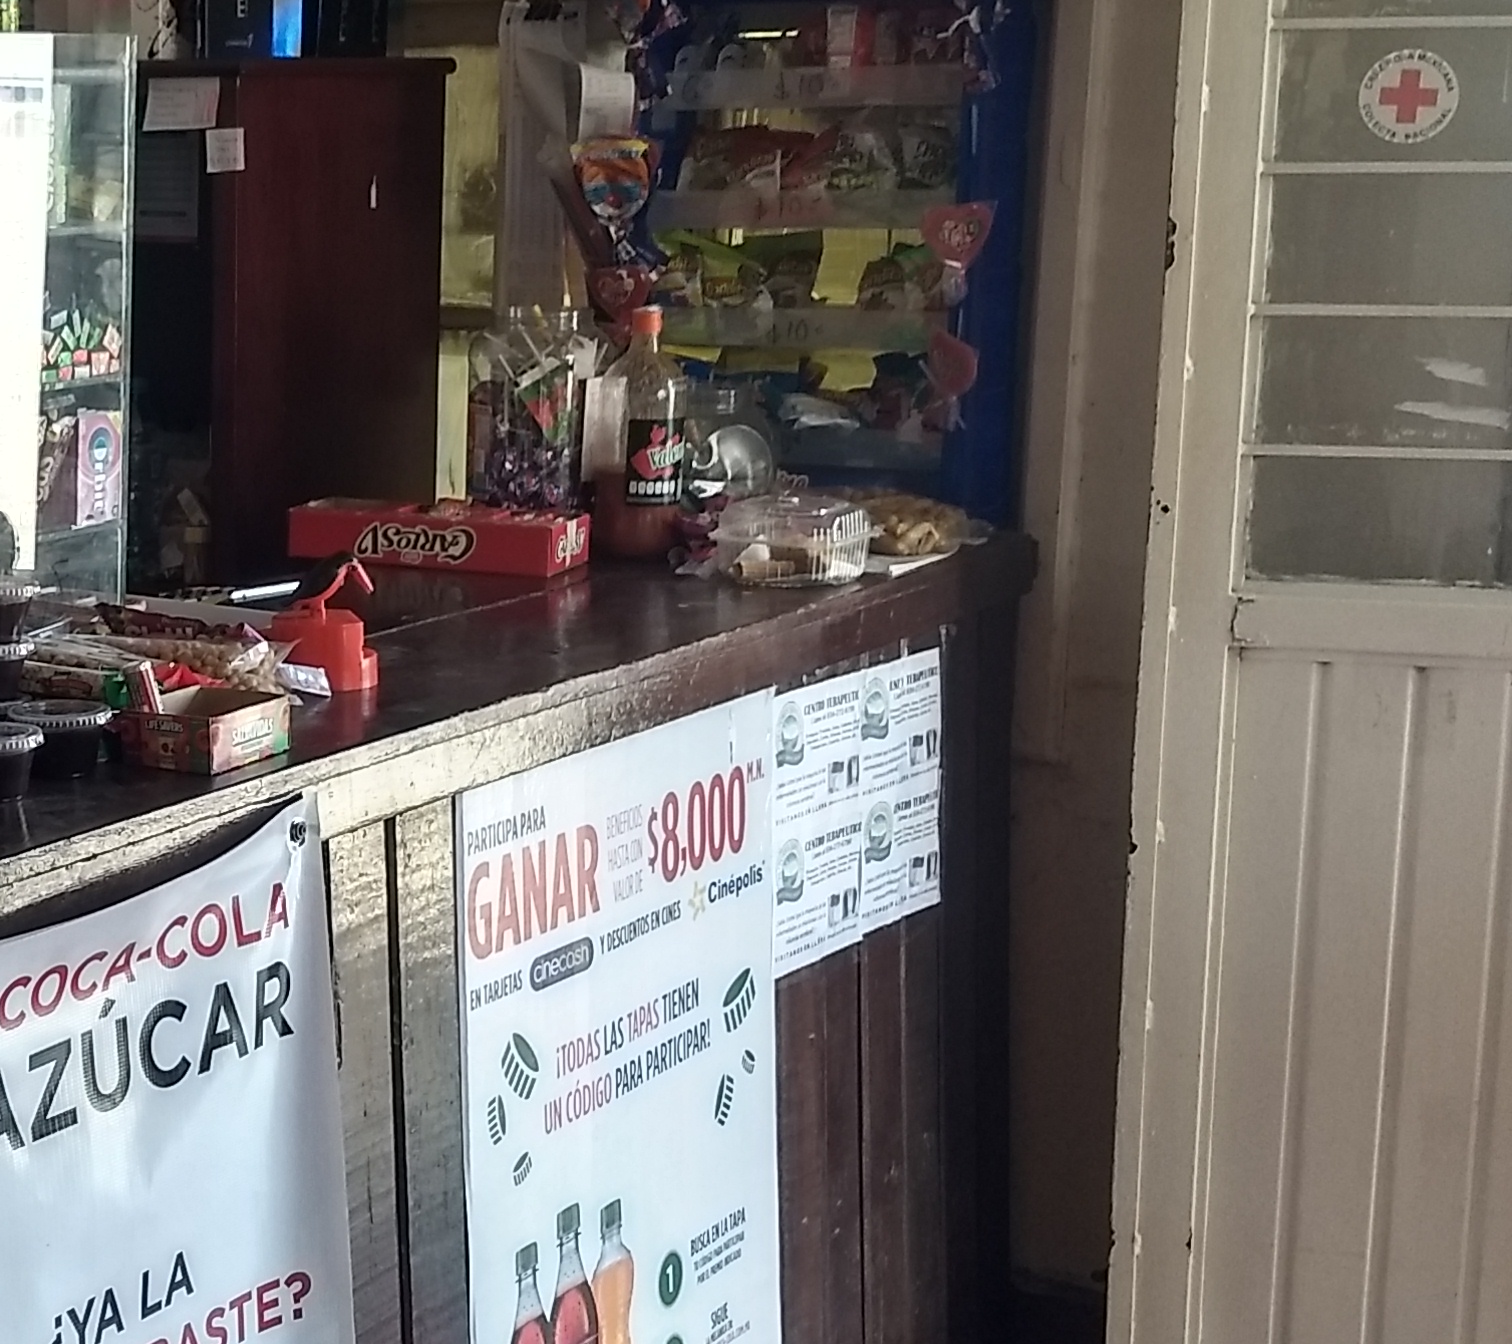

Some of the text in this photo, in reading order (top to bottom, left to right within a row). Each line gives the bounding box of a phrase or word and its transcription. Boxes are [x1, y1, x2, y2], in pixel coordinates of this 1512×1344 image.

[468, 805, 546, 856] PARTICIPA PARA
[605, 804, 644, 842] BENEFICIOS
[646, 763, 748, 884] $8,000
[467, 823, 602, 961] GANAR
[707, 863, 764, 904] Cinépolis
[469, 989, 482, 1012] EN
[482, 972, 524, 1008] TARJETAS
[532, 940, 591, 984] cinecash
[606, 917, 651, 954] DESCUENTOS
[651, 912, 661, 933] EN
[661, 899, 682, 928] CINES
[555, 977, 700, 1082] ¡TODAS LAS TAPAS TIENEN
[544, 1017, 712, 1135] UN CÓDIGO PARA PARTICIPAR!
[690, 1206, 747, 1258] BUSCA EN LA TAPA
[140, 1250, 195, 1320] LA
[665, 1263, 675, 1294] 1
[709, 1301, 729, 1330] SIGUE
